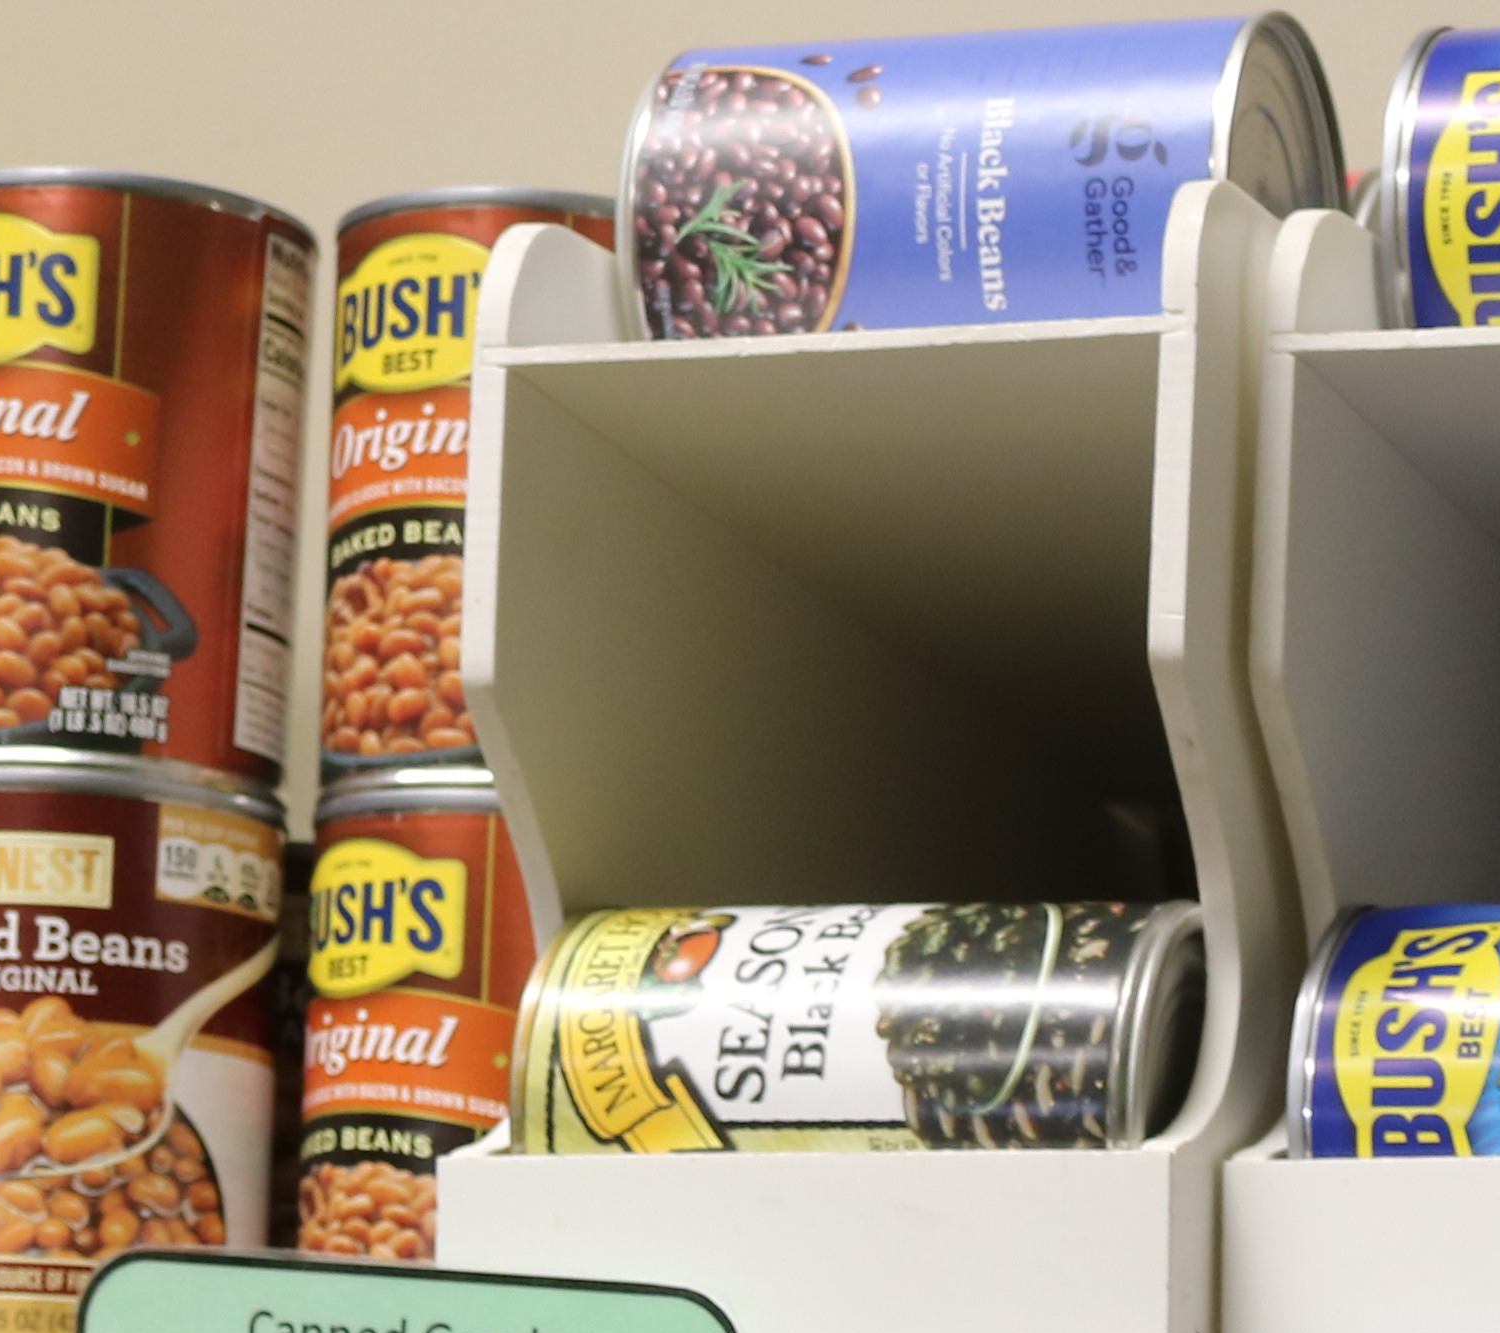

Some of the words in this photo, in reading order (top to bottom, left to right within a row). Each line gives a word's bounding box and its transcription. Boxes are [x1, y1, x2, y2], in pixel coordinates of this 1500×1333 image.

[937, 155, 953, 221] Artificial
[934, 226, 953, 282] Colors
[976, 196, 1009, 312] Beans
[1084, 177, 1108, 279] Gather
[382, 348, 437, 375] BEST
[32, 919, 190, 975] Beans
[327, 955, 368, 980] BEST
[1372, 925, 1482, 1156] BUSH'S
[1458, 989, 1487, 1059] BEST
[341, 1125, 434, 1159] BEANS
